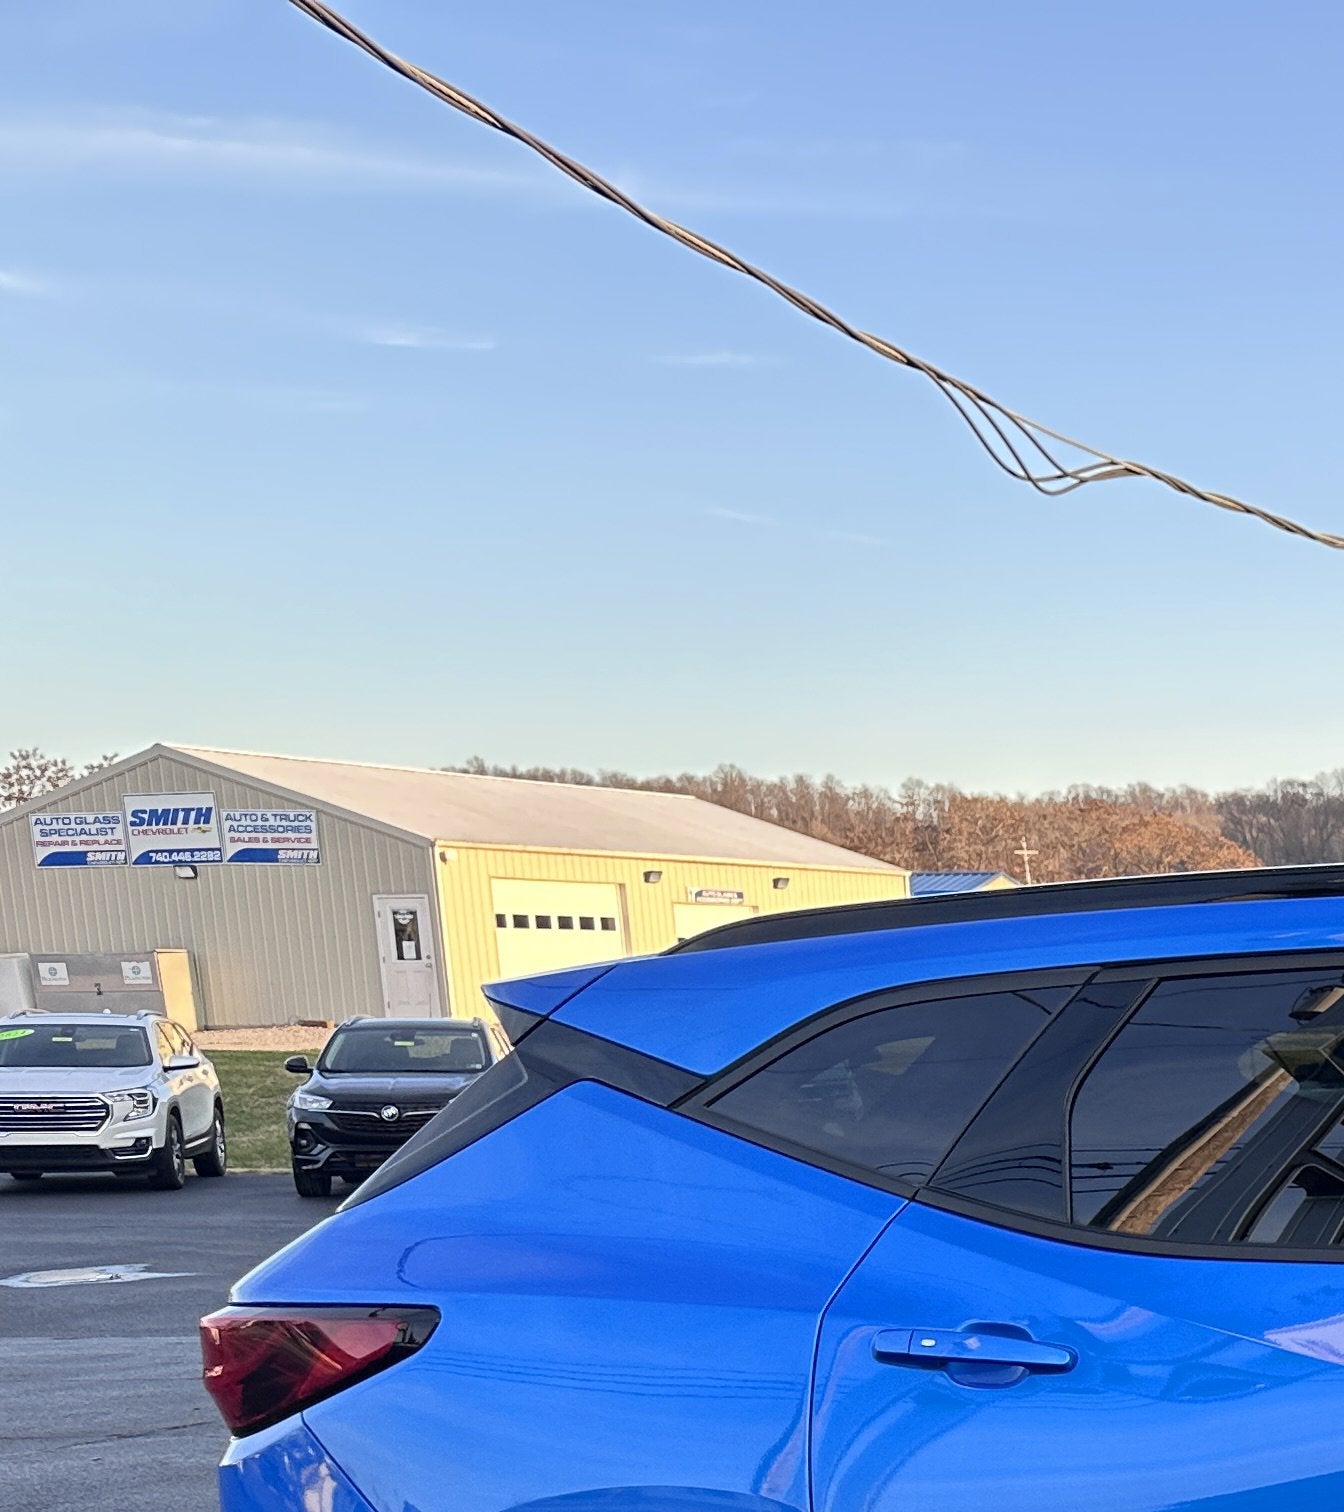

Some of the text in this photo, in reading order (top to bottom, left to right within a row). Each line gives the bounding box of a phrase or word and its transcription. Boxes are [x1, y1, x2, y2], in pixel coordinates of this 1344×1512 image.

[34, 816, 120, 826] AUTO GLASS
[129, 807, 213, 827] SMITH
[225, 813, 313, 822] AUTO & TRUCK
[39, 827, 116, 837] SPECIALIST
[132, 827, 189, 836] CHEVROLET
[228, 824, 312, 834] ACCESSORIES
[86, 852, 126, 860] SMITH
[278, 849, 318, 859] SMITH
